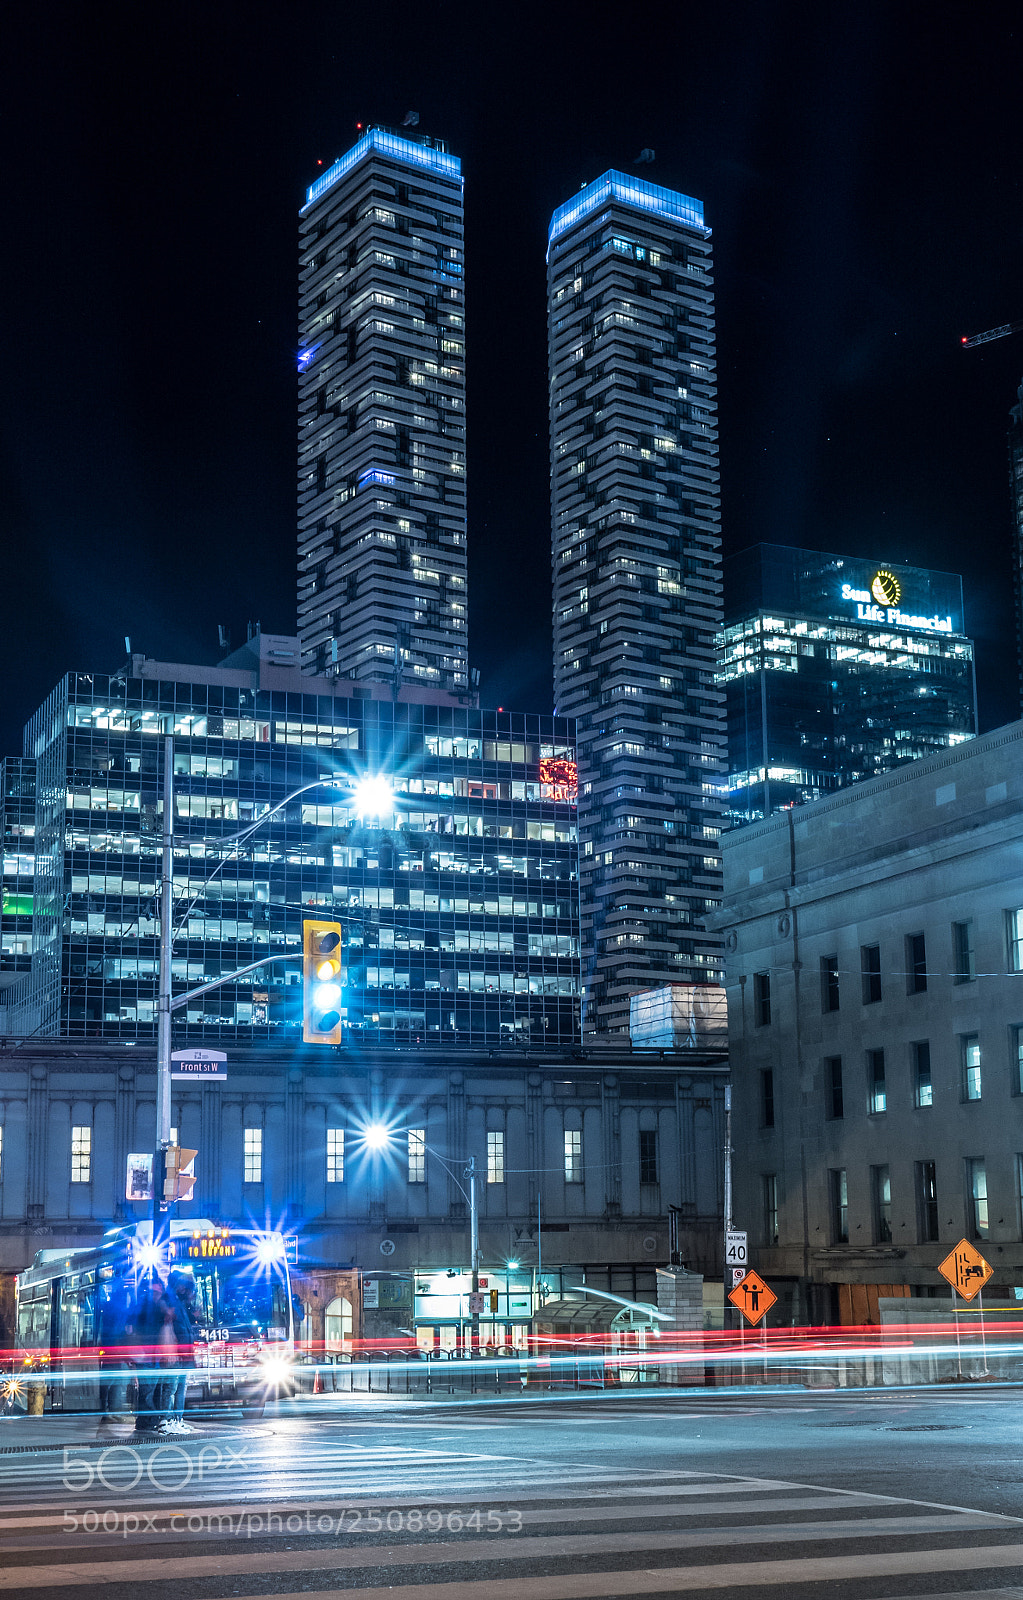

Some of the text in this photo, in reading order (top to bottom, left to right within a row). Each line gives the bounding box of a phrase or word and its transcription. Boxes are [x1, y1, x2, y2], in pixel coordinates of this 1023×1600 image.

[841, 584, 871, 602] Sun
[857, 603, 952, 632] Life Financial
[180, 1062, 202, 1071] Front
[211, 1063, 218, 1071] W
[728, 1245, 745, 1260] 40
